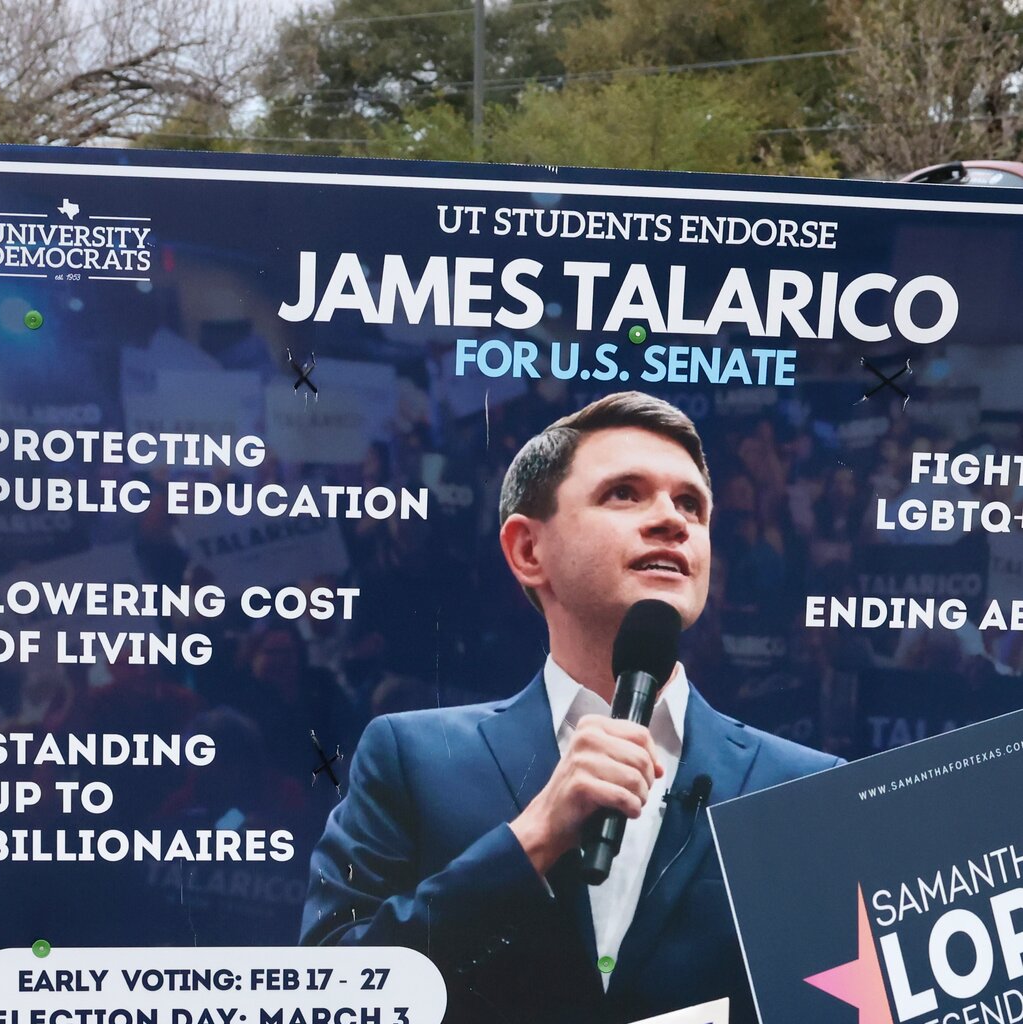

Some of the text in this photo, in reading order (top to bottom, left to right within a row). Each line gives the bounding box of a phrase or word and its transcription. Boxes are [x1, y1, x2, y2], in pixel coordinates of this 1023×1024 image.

[438, 205, 839, 249] UT STUDENTS ENDORSE
[66, 273, 82, 282] 1953
[277, 250, 960, 344] JAMES TALARICO
[454, 338, 798, 387] FOR U.S. SENATE
[167, 481, 429, 520] EDUCATION
[240, 586, 360, 620] COST
[804, 596, 968, 630] ENDING
[57, 632, 213, 666] LIVING
[55, 781, 113, 814] TO
[18, 968, 109, 992] EARLY
[121, 968, 242, 991] VOTING:
[250, 968, 300, 991] FEB
[306, 968, 333, 991] 17
[360, 968, 391, 991] 27
